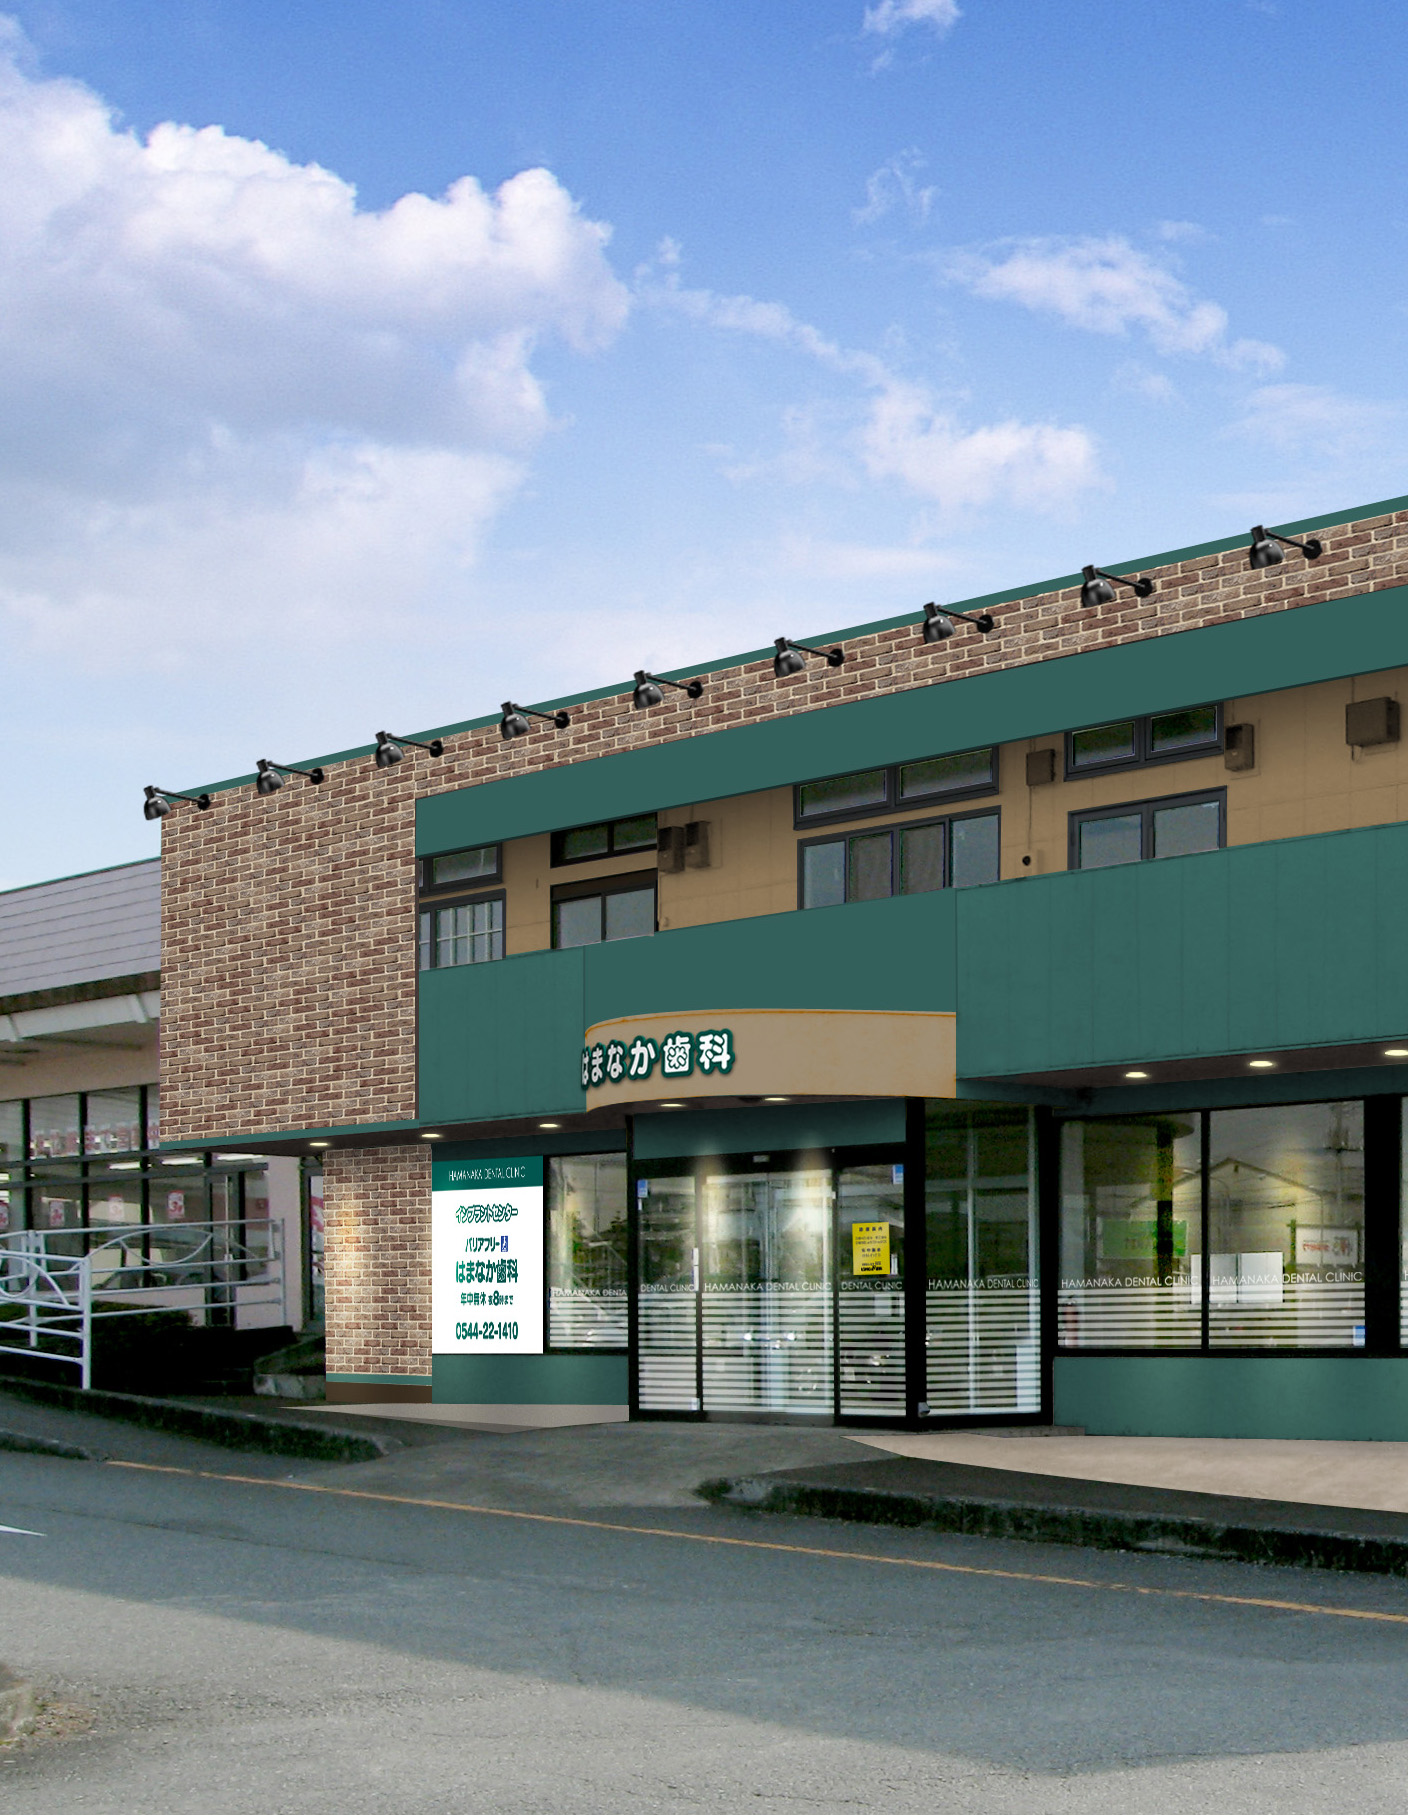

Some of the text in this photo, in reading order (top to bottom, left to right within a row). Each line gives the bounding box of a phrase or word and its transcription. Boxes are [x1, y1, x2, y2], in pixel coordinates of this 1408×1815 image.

[581, 1032, 732, 1086] はまなか歯科
[448, 1165, 526, 1182] HAMANAKA DENTAL CLINIC
[455, 1202, 519, 1224] インプラントセンター
[465, 1236, 500, 1253] バリアフリー
[455, 1258, 519, 1284] はまなか歯科
[1212, 1271, 1363, 1287] HAMANAKA DENTAL CLINIC
[640, 1283, 695, 1293] DENTAL CLINIC
[704, 1281, 832, 1292] HAMANAKA DENTAL CLINIC
[841, 1280, 903, 1291] DENTAL CLINIC
[928, 1277, 1039, 1291] HAMANAKA DENTAL CLINIC
[1061, 1274, 1199, 1289] HAMANAKA DENTAL CLINIC
[455, 1321, 519, 1340] 0544-22-1410
